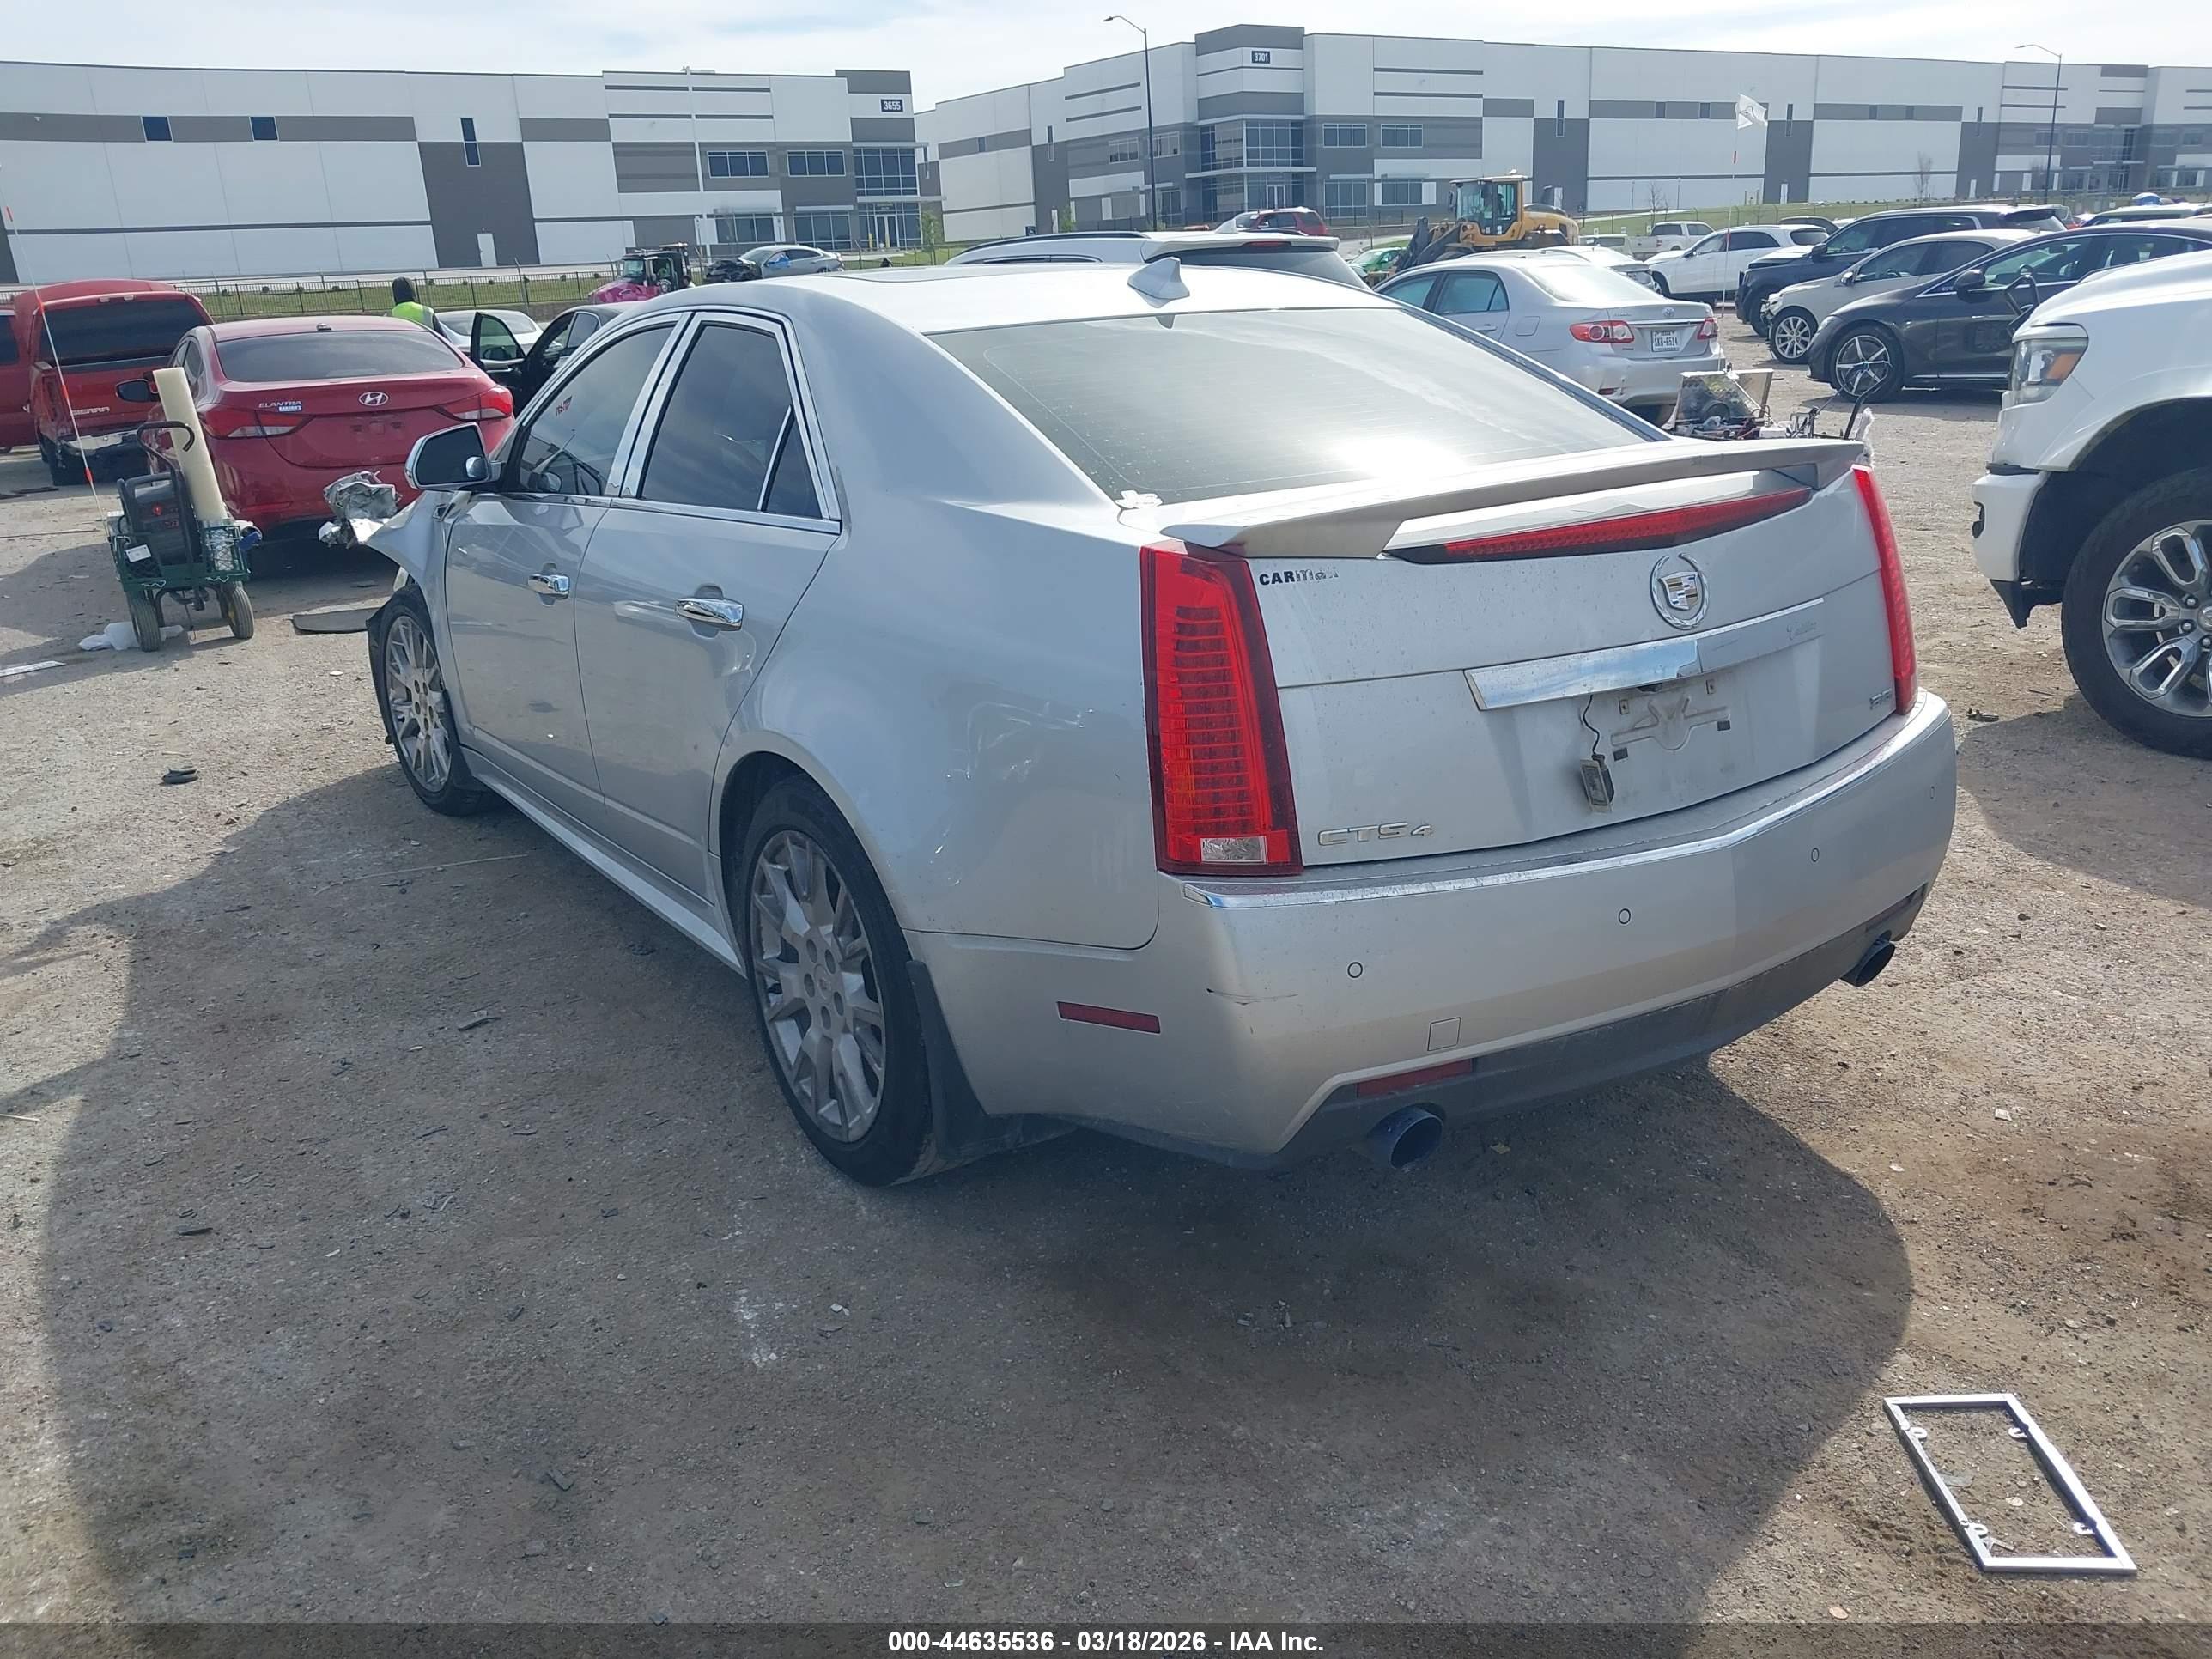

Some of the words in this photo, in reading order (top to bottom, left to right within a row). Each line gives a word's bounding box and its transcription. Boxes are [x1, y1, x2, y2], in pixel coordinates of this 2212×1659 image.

[1254, 52, 1268, 62] 3701
[883, 100, 901, 111] 3655
[258, 400, 302, 409] ELANTRA
